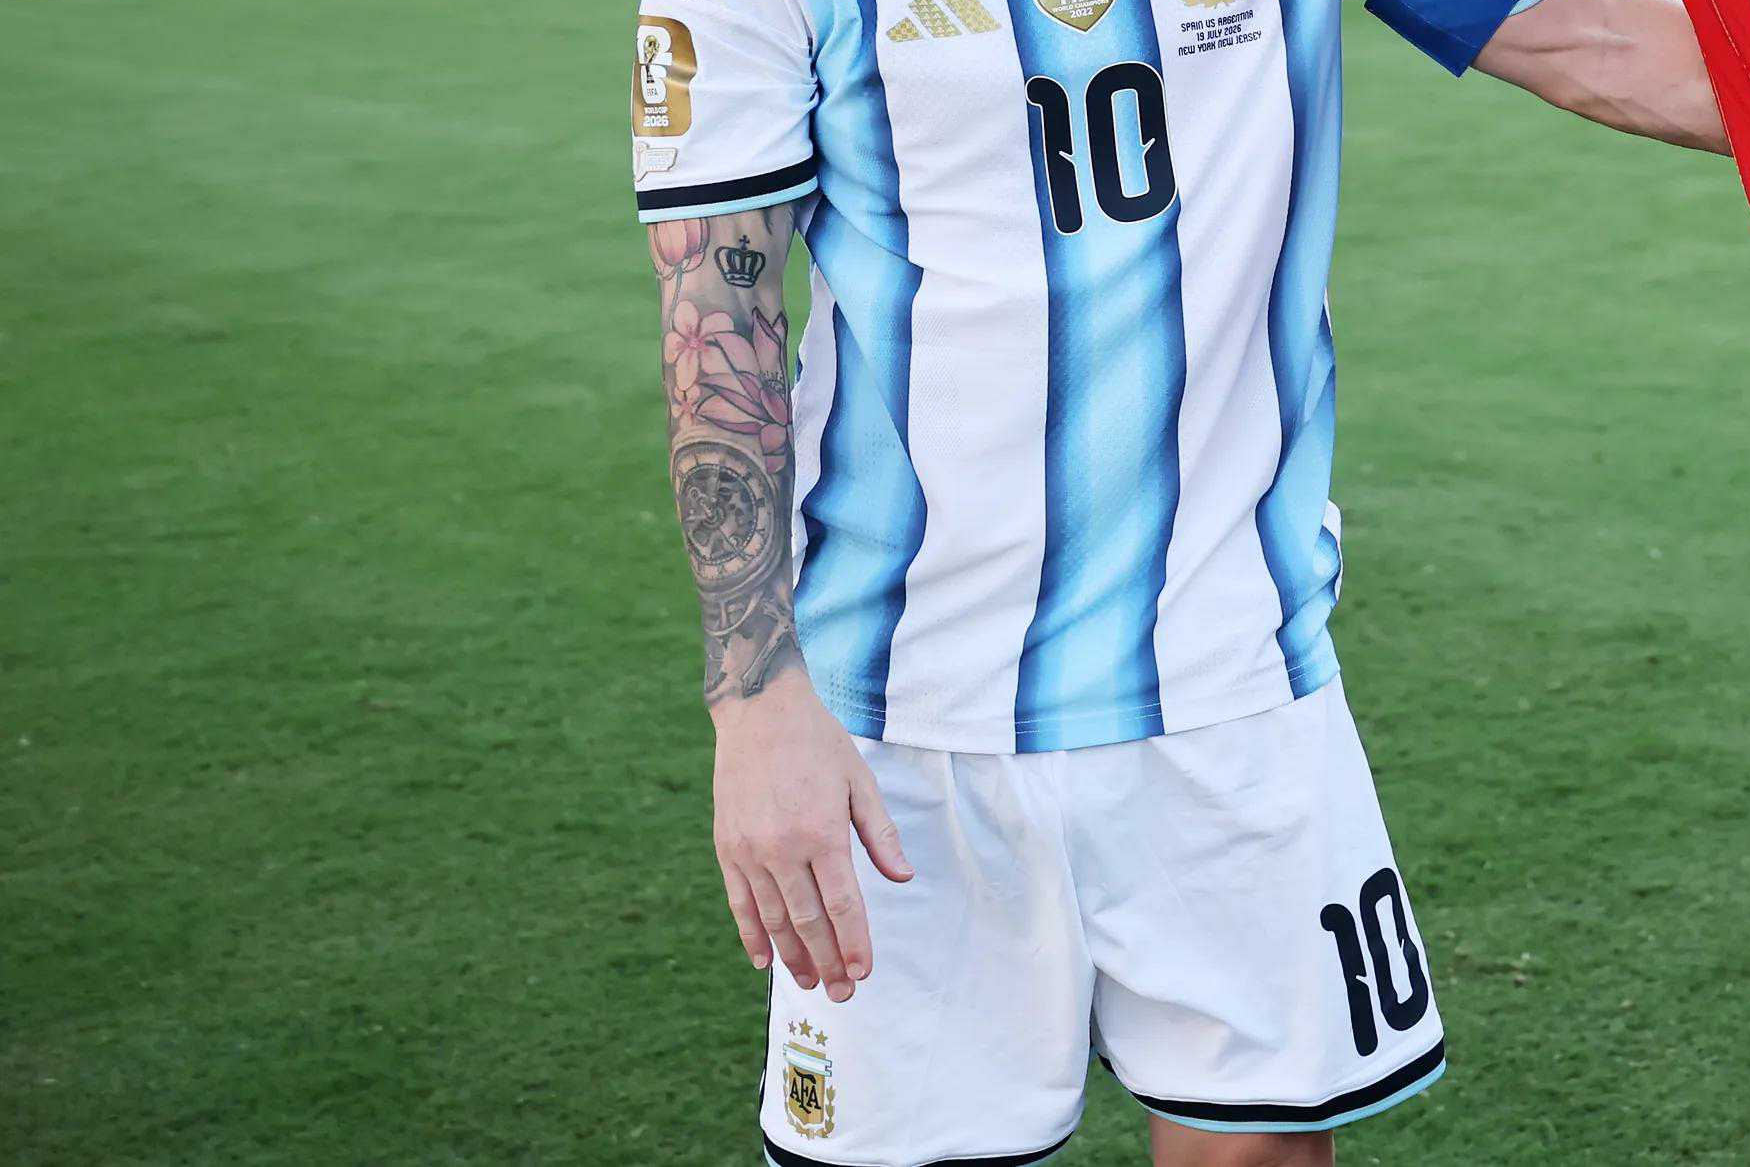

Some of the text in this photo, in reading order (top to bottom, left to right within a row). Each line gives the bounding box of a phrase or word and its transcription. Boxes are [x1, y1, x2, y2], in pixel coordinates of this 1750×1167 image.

[1052, 4, 1074, 13] WORLD
[1070, 7, 1094, 19] 2022
[1180, 20, 1203, 32] SPAIN
[1217, 9, 1254, 26] ARGENTINA
[1178, 30, 1262, 57] NEW YORK NEW JERSEY
[1196, 24, 1241, 41] 19 JULY 2026
[643, 115, 669, 127] 2026
[1025, 60, 1178, 235] 10
[1320, 867, 1429, 1057] 10
[790, 1067, 821, 1114] AFA
